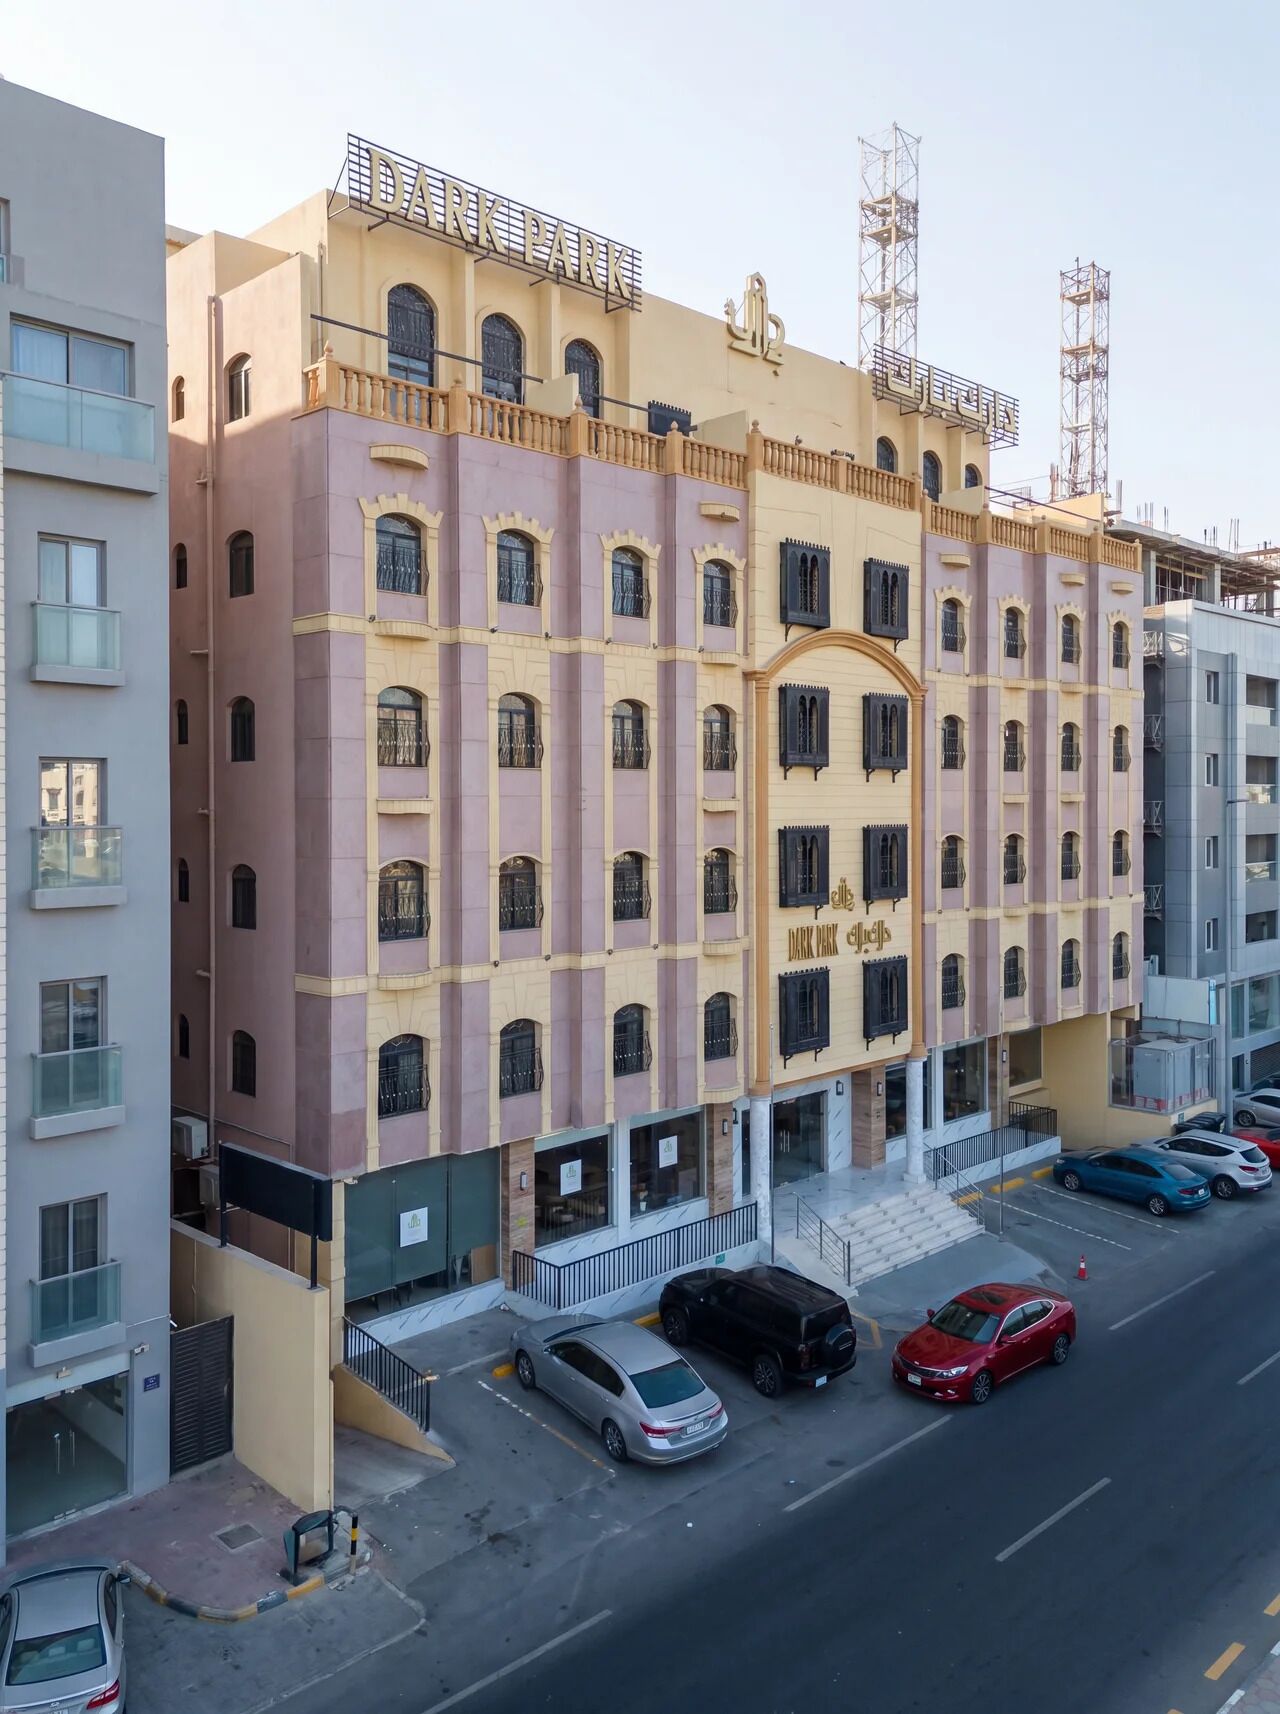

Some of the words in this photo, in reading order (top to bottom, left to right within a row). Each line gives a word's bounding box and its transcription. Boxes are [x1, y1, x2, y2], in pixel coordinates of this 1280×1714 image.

[367, 147, 507, 253] DARK
[521, 209, 632, 298] PARK
[886, 357, 952, 418] بارك
[956, 383, 1017, 435] دارك
[788, 925, 815, 961] DARK
[816, 923, 839, 958] PARK
